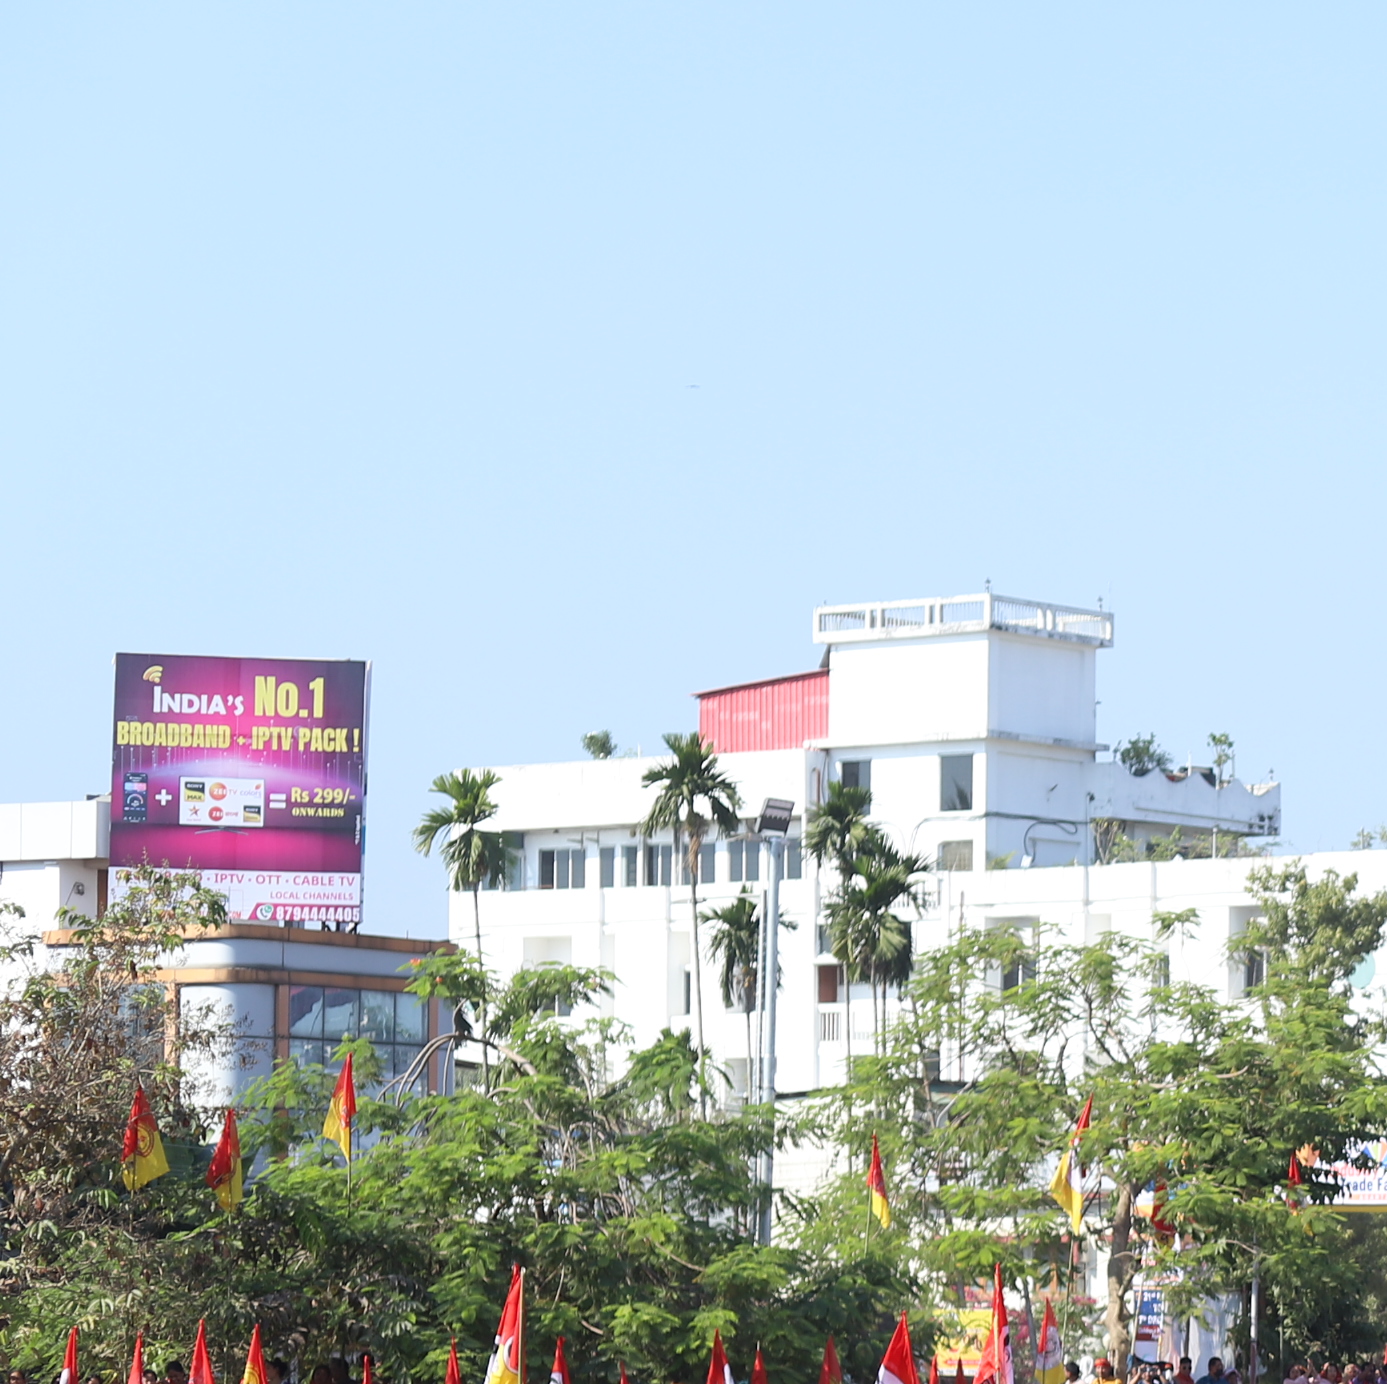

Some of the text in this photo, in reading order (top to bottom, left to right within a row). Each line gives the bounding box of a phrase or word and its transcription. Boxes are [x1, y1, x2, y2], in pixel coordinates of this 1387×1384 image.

[116, 721, 231, 748] BROADBAND
[251, 727, 293, 750] IPTV
[298, 728, 348, 752] PACK
[291, 787, 309, 803] Rs
[291, 806, 344, 818] ONWARDS
[214, 872, 245, 884] IPTV
[255, 874, 282, 885] OTT
[293, 875, 335, 887] CABLE
[338, 876, 356, 887] TV
[270, 891, 354, 901] LOCAL CHANNELS
